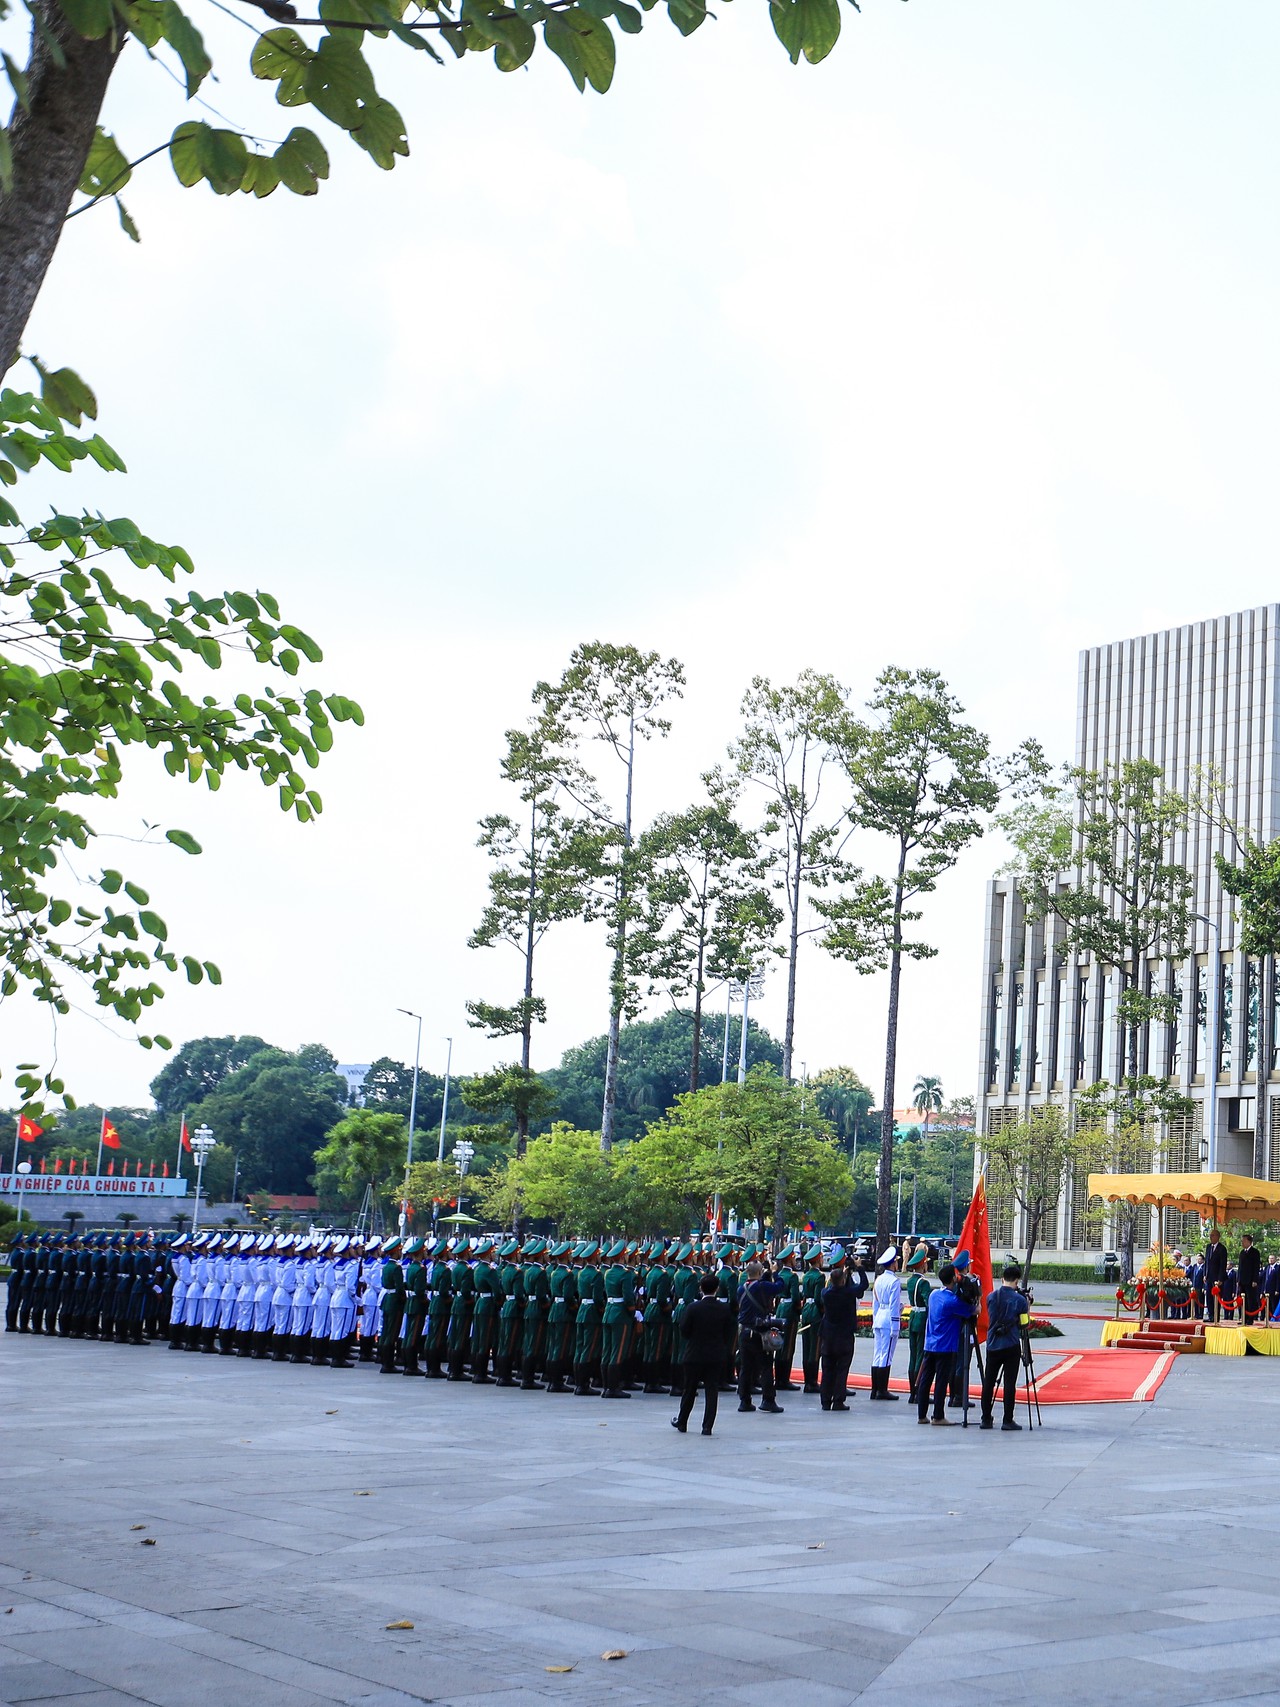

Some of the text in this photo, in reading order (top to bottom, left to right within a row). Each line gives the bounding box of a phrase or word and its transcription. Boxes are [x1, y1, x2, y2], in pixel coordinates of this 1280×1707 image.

[0, 1176, 11, 1192] Ự
[16, 1176, 62, 1192] NGHIỆP
[66, 1175, 90, 1190] CỦA
[142, 1181, 155, 1192] TA
